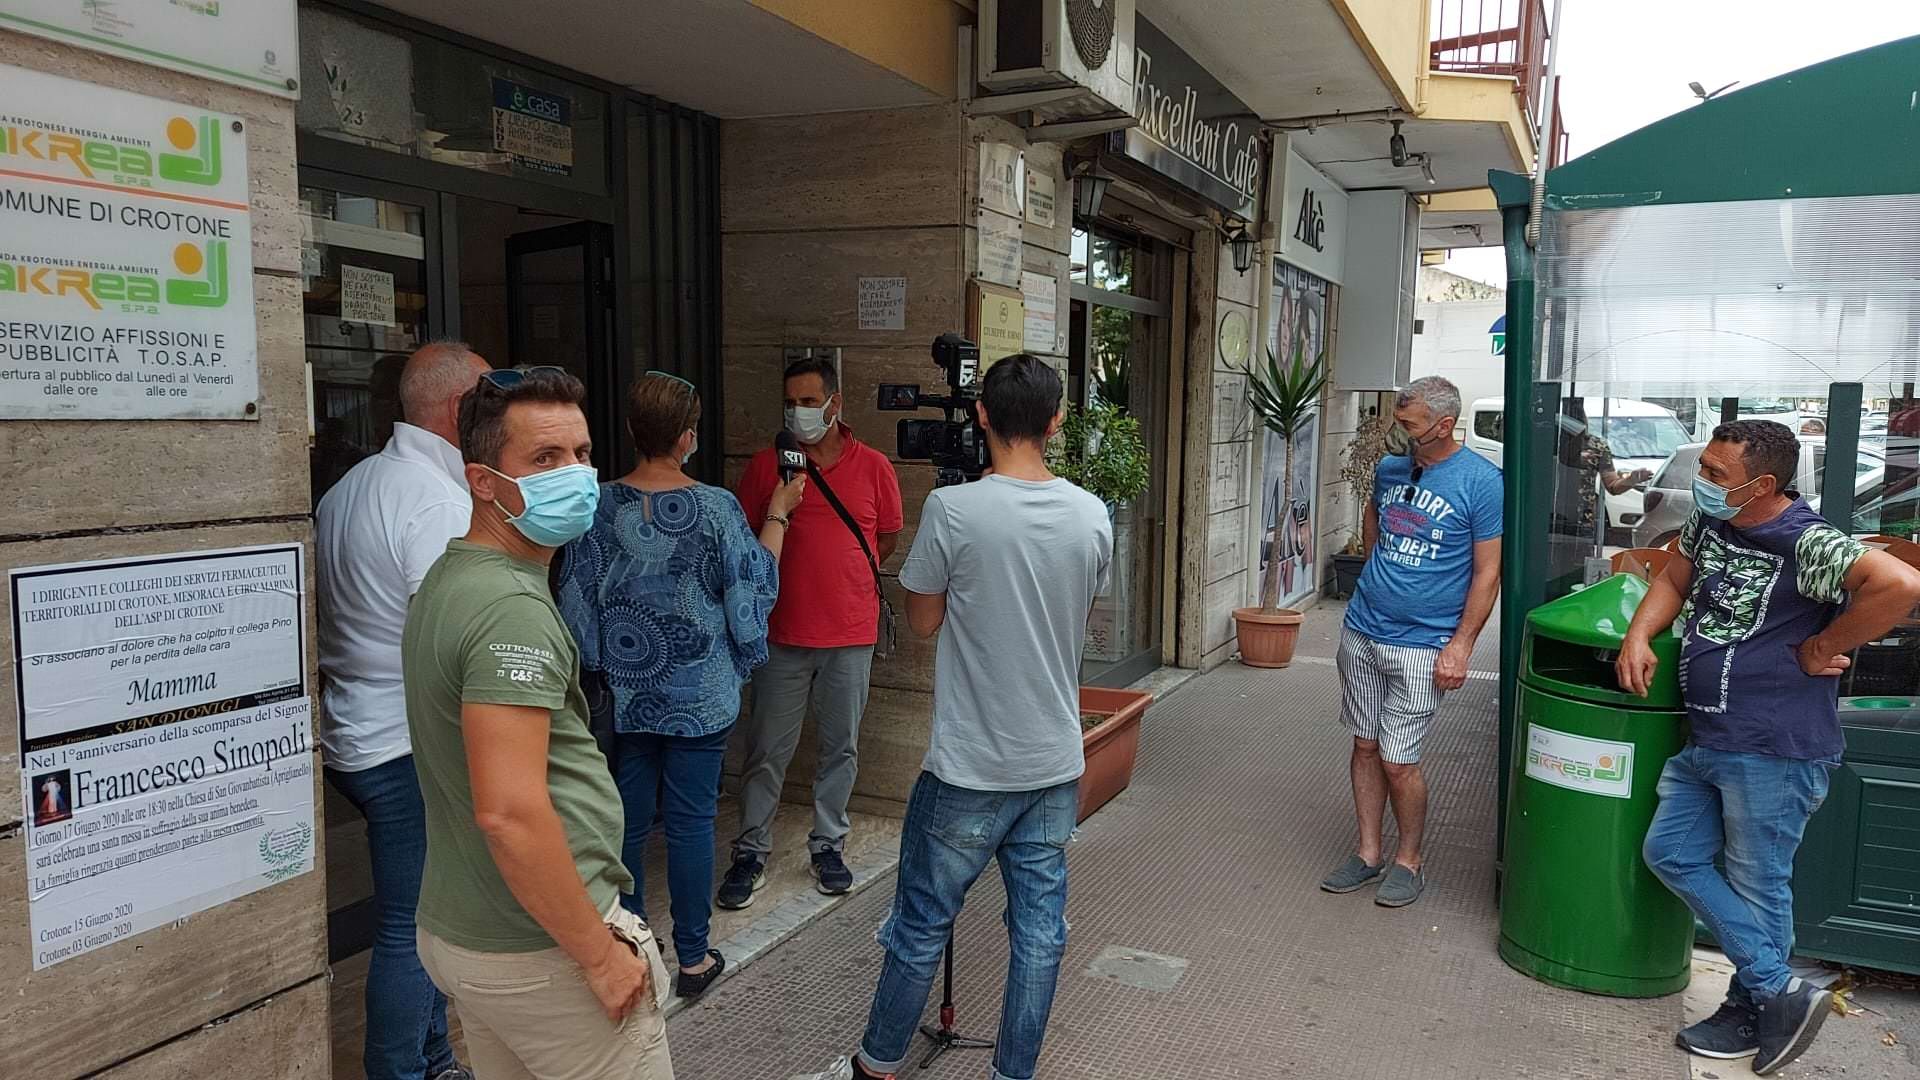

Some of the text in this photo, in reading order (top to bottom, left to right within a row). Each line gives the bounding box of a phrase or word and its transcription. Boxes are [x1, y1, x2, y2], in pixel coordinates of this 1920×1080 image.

[527, 96, 560, 117] casa
[1133, 48, 1220, 172] Excellent
[11, 116, 67, 133] KROTONESE
[69, 126, 108, 141] ENERGIA
[110, 134, 151, 148] AMBIENTE
[90, 201, 112, 223] DI
[120, 206, 232, 239] CROTONE
[20, 255, 75, 267] KROTONESE
[77, 260, 115, 270] ENERGIA
[118, 264, 159, 275] AMBIENTE
[102, 327, 208, 348] AFFISSIONI
[214, 334, 225, 349] E
[137, 349, 228, 368] T.O.S.A.P.
[0, 368, 234, 385] ertura al pubblico dal Lunedì al Venerdì
[43, 383, 99, 396] dalle ore
[145, 385, 188, 398] alle ore
[1398, 536, 1441, 560] DEPT
[39, 584, 97, 604] DIRIGENTI
[100, 583, 108, 596] E
[109, 577, 163, 595] COLLEGHI
[165, 575, 182, 588] DEI
[183, 571, 220, 585] SERVIZI
[222, 563, 287, 581] FERMACEUTICI
[22, 601, 102, 623] TERRITORIALI
[104, 599, 117, 613] DI
[173, 586, 225, 604] MESORACA
[114, 602, 225, 629] DELL'ASP DI CROTONE
[31, 654, 43, 666] Si
[46, 646, 105, 664] associano
[108, 643, 119, 655] al
[121, 638, 155, 653] dolore
[157, 635, 177, 647] che
[179, 632, 192, 644] ha
[194, 626, 227, 641] colpito
[236, 620, 270, 634] collega
[271, 617, 293, 629] Pino
[110, 640, 231, 671] per la perdita della cara
[126, 671, 218, 706] Mamma
[510, 669, 534, 681] C&S
[31, 752, 56, 771] Nel
[159, 726, 189, 741] della
[191, 714, 252, 737] scomparsa
[254, 705, 272, 722] del
[274, 702, 309, 719] Signor
[74, 721, 306, 809] Francesco Sinopoli
[35, 830, 61, 847] Giorno
[63, 823, 73, 840] 17
[74, 819, 101, 837] Giugno
[102, 811, 120, 829] 2020
[121, 807, 134, 823] alle
[135, 807, 147, 820] ore
[148, 799, 167, 817] 18:30
[168, 795, 184, 812] nella
[184, 790, 207, 806] Chiesa
[215, 783, 227, 800] San
[53, 847, 86, 865] celebrata
[87, 843, 100, 855] una
[101, 837, 120, 852] santa
[121, 832, 142, 846] messa
[181, 812, 197, 829] della
[198, 811, 209, 824] sua
[35, 877, 46, 891] La
[47, 866, 79, 884] famiglia
[81, 858, 113, 877] ringrazia
[114, 850, 137, 869] quanti
[138, 838, 180, 863] prenderanno
[181, 834, 199, 850] parte
[200, 828, 212, 844] alla
[40, 901, 133, 942] Crotone 15 Giugno 2020
[39, 920, 132, 965] Crotone 03 Giugno 2020
